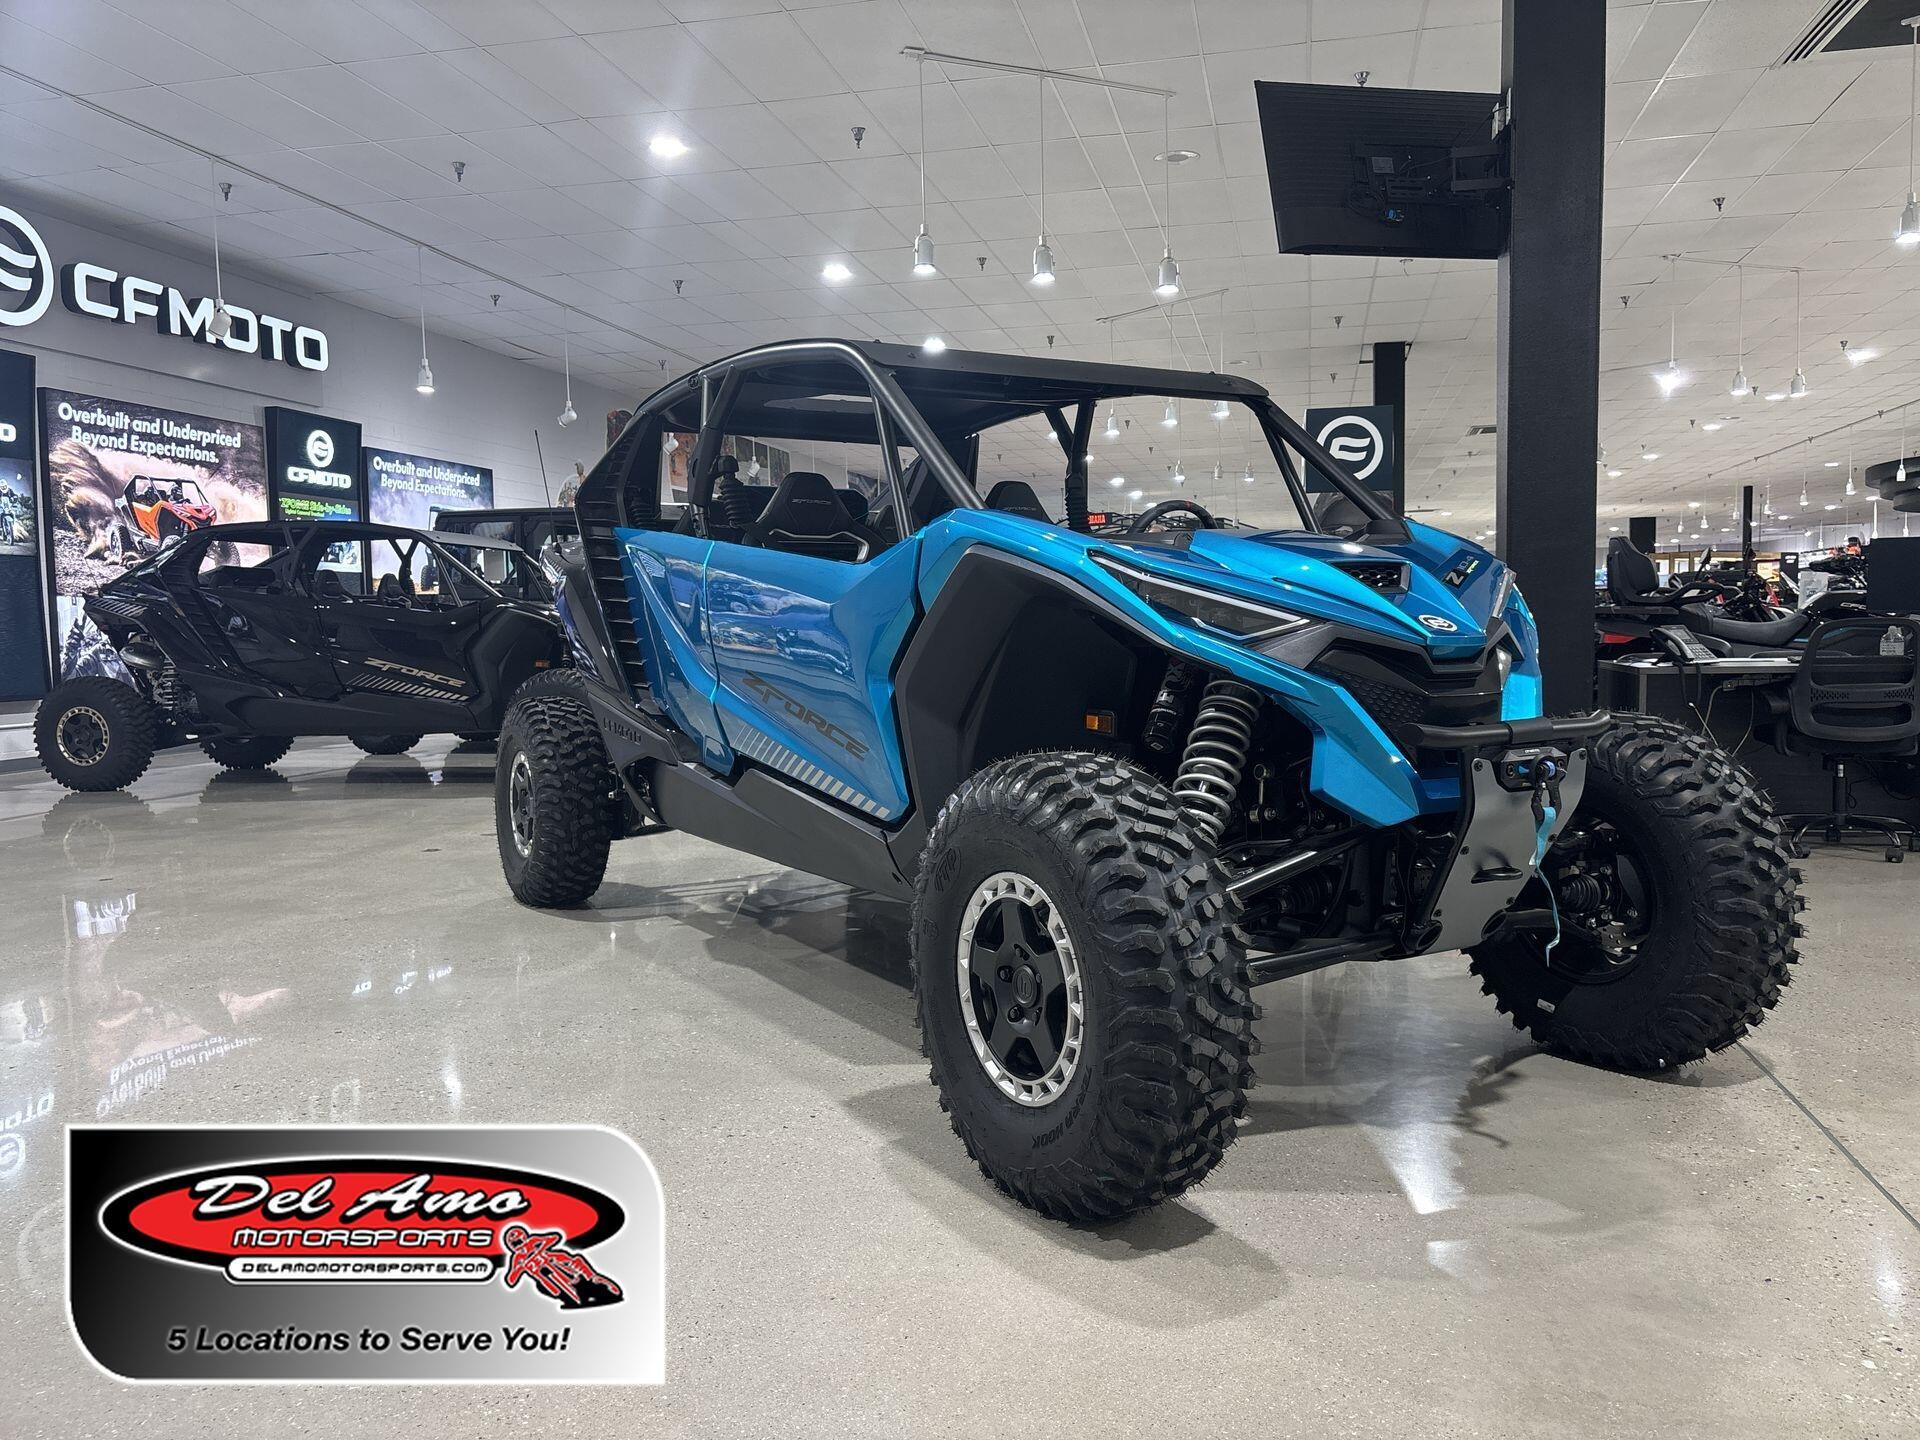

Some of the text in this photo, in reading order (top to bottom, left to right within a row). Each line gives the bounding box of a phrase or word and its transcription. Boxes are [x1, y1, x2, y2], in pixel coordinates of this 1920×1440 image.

[73, 262, 329, 371] CFMOTO
[57, 402, 242, 449] Overbuilt and Underpriced
[71, 425, 220, 464] Beyond Expectations.
[286, 466, 352, 489] CFMOTO
[373, 455, 480, 487] Overbuilt and Underpriced
[381, 473, 468, 499] Beyond Expectations.
[364, 656, 467, 688] ZFORCE
[742, 669, 870, 762] ZFORCE
